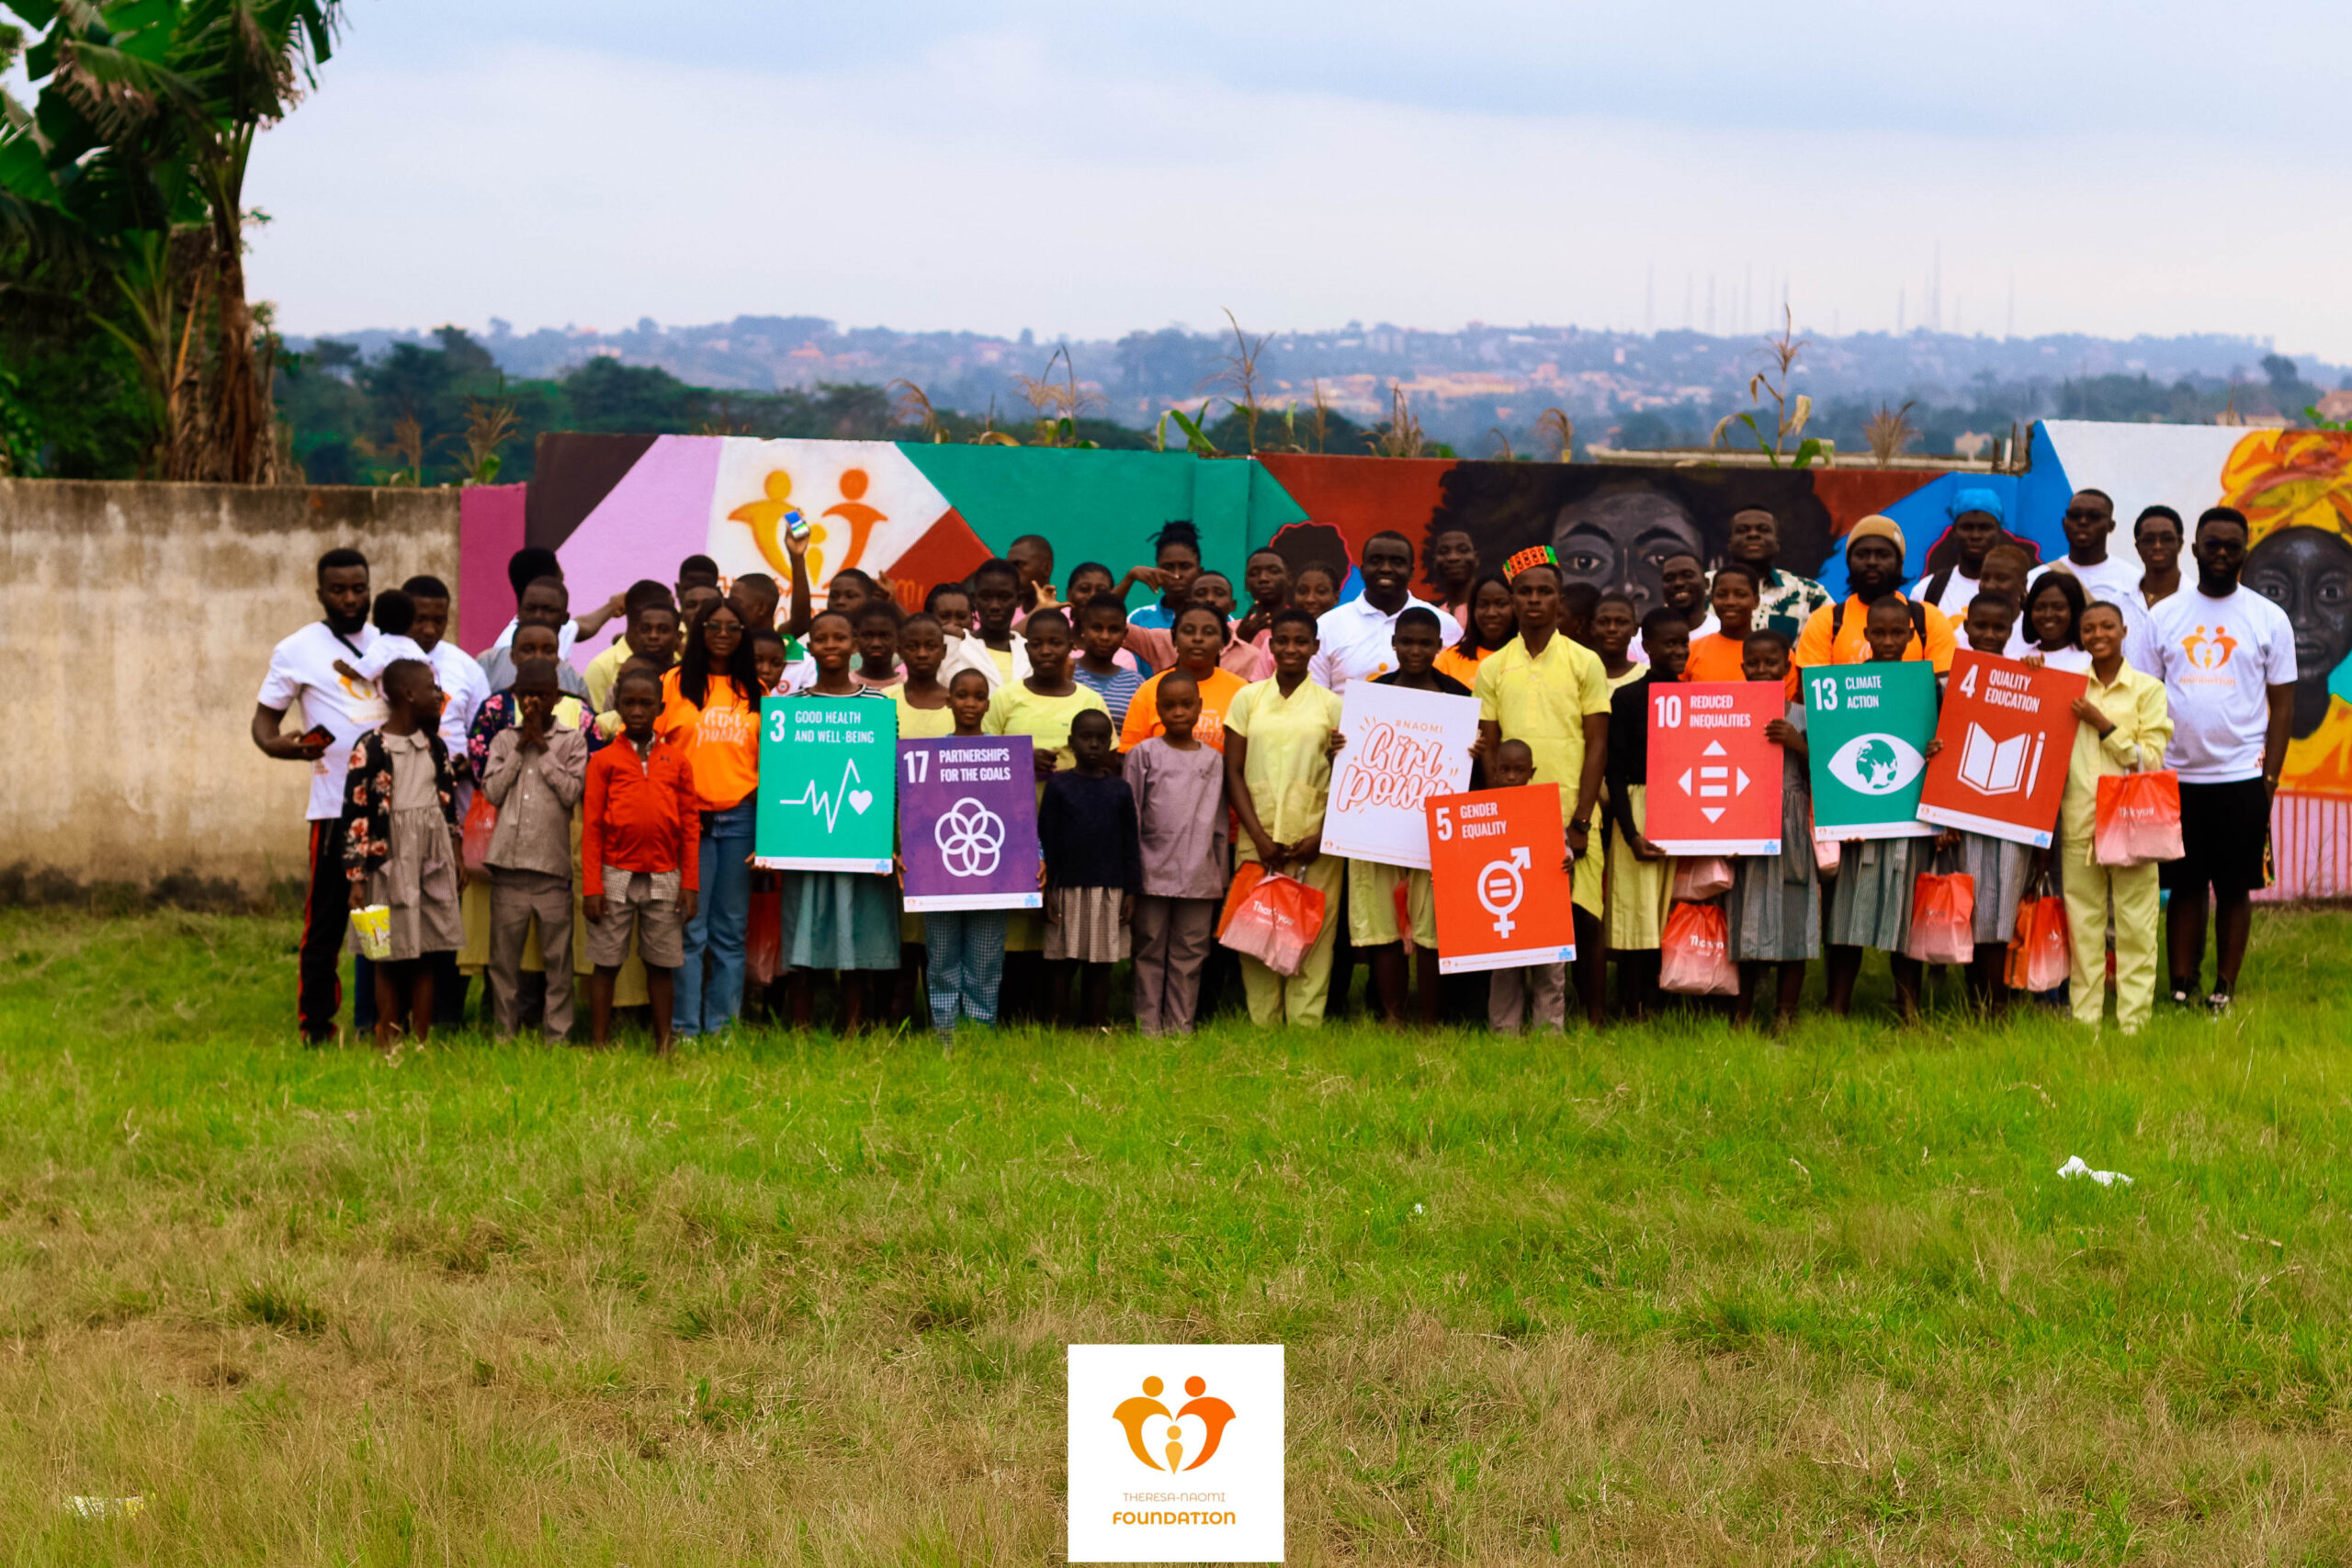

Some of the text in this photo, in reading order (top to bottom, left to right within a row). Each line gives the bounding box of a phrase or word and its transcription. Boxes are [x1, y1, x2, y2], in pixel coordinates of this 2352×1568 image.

[1845, 675, 1882, 690] CLIMATE
[1960, 664, 1979, 698] 4
[1988, 669, 2031, 692] QUALITY
[1690, 694, 1734, 709] REDUCED
[1811, 678, 1838, 710] 13
[1847, 695, 1879, 709] ACTION
[1984, 687, 2041, 713] EDUCATION
[795, 711, 861, 724] GOOD HEALTH
[1655, 694, 1682, 728] 10
[770, 710, 786, 742] 3
[1395, 719, 1443, 733] #NAOMI
[1690, 714, 1751, 729] INEQUALITIES
[795, 730, 875, 743] AND WELL-BEING
[939, 748, 1010, 763] PARTNERSHIPS
[1362, 723, 1443, 779] Girl
[903, 750, 930, 784] 17
[940, 767, 1011, 783] FOR THE GOALS
[1460, 802, 1498, 819] GENDER
[1436, 807, 1453, 841] 5
[1462, 820, 1507, 840] EQUALITY
